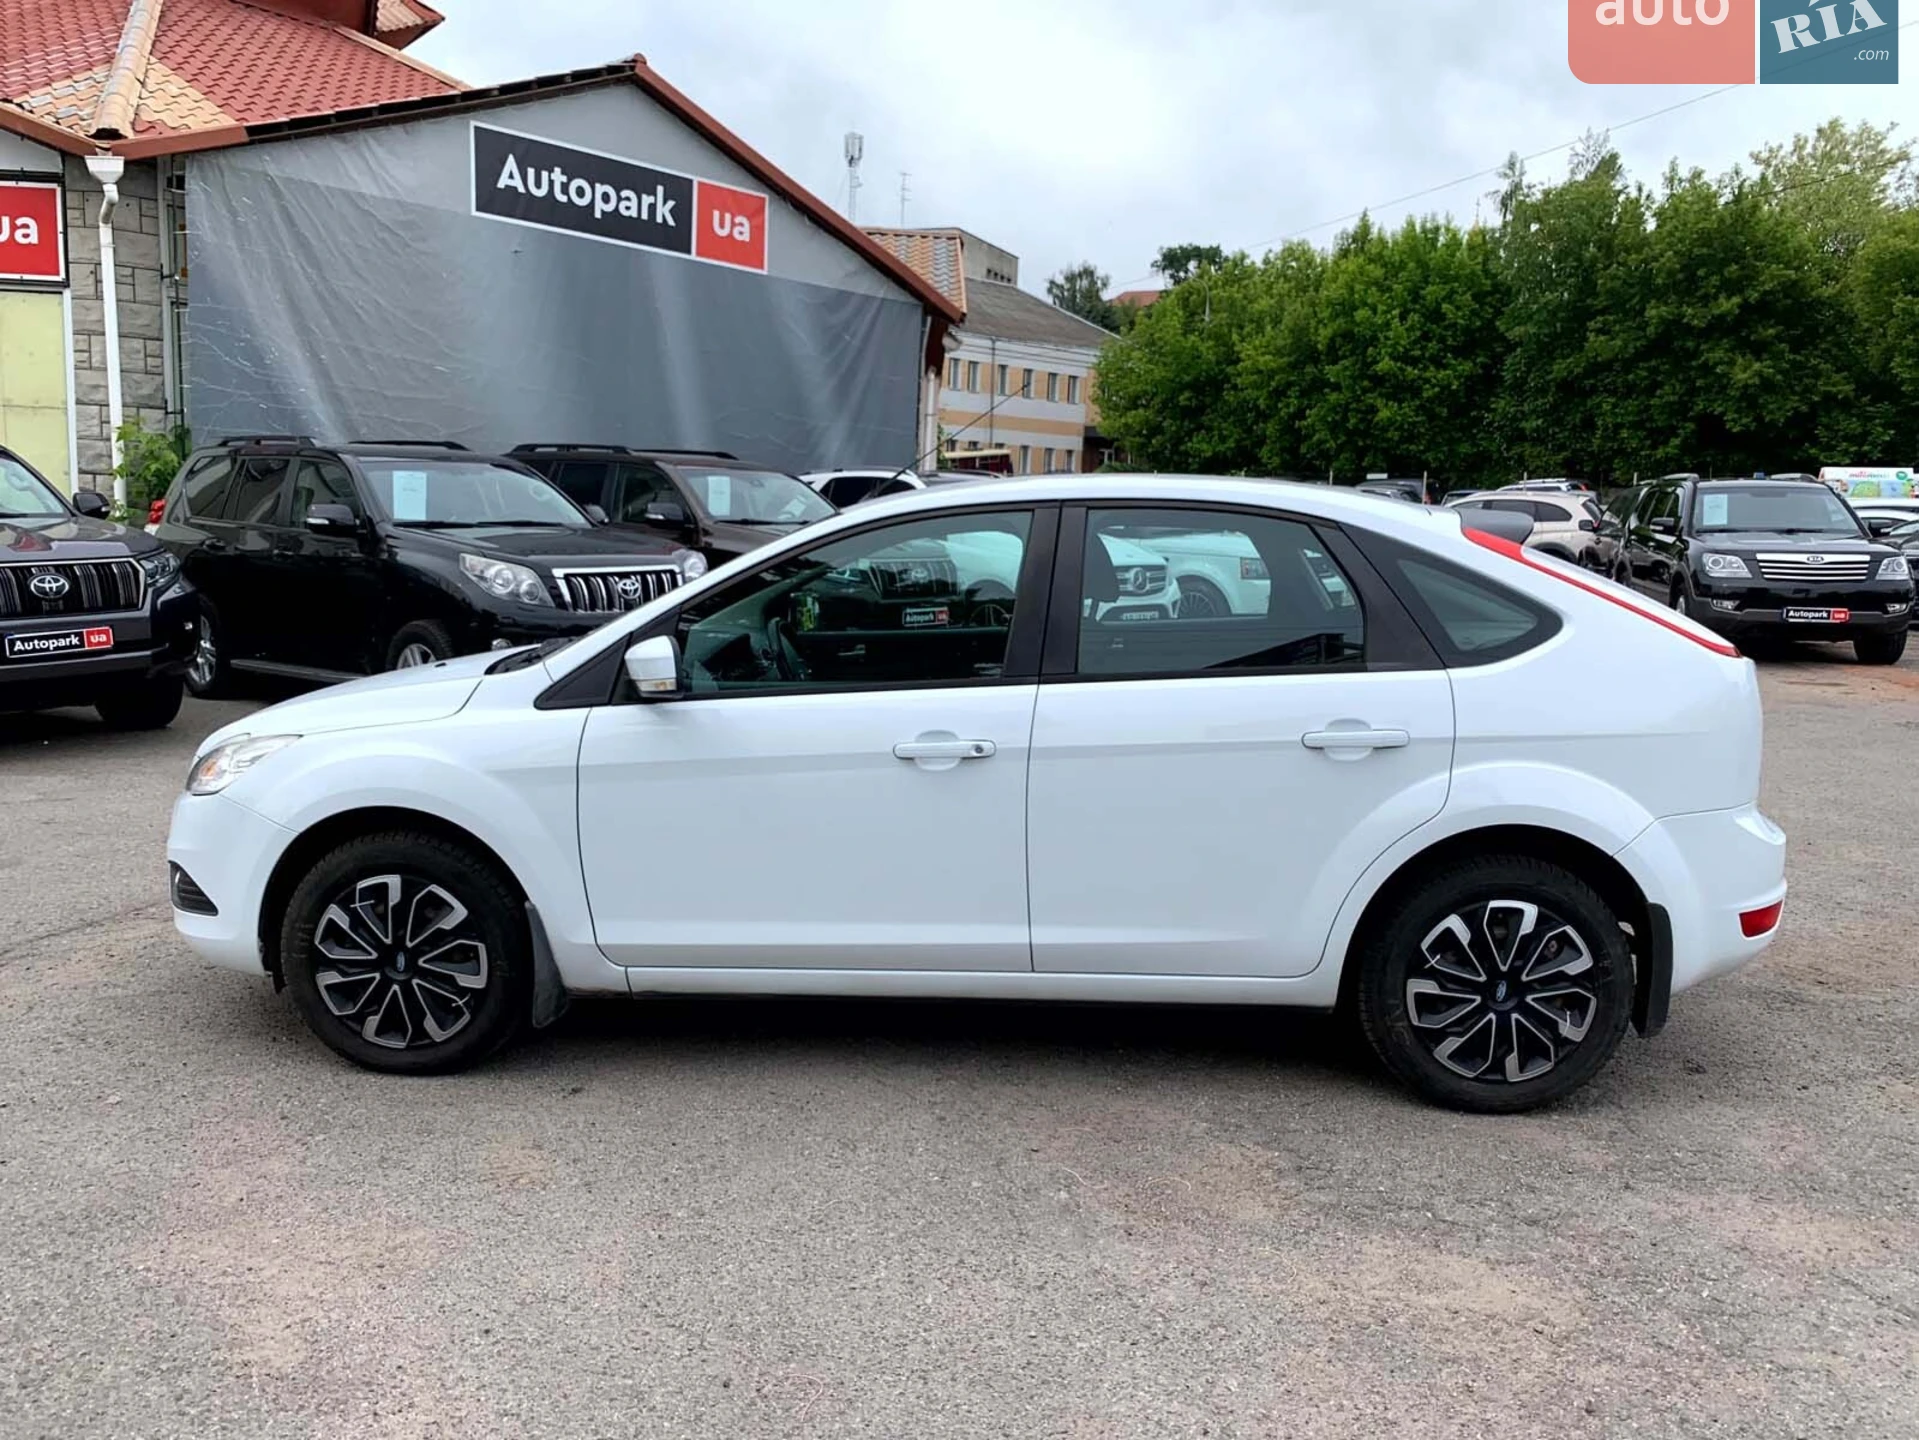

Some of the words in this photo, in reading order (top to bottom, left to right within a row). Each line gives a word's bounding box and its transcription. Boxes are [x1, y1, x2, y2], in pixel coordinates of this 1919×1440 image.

[496, 153, 676, 227] Autopark
[712, 209, 751, 242] ua
[1788, 610, 1828, 619] Autopark
[13, 634, 80, 652] Autopark
[89, 633, 107, 643] ua
